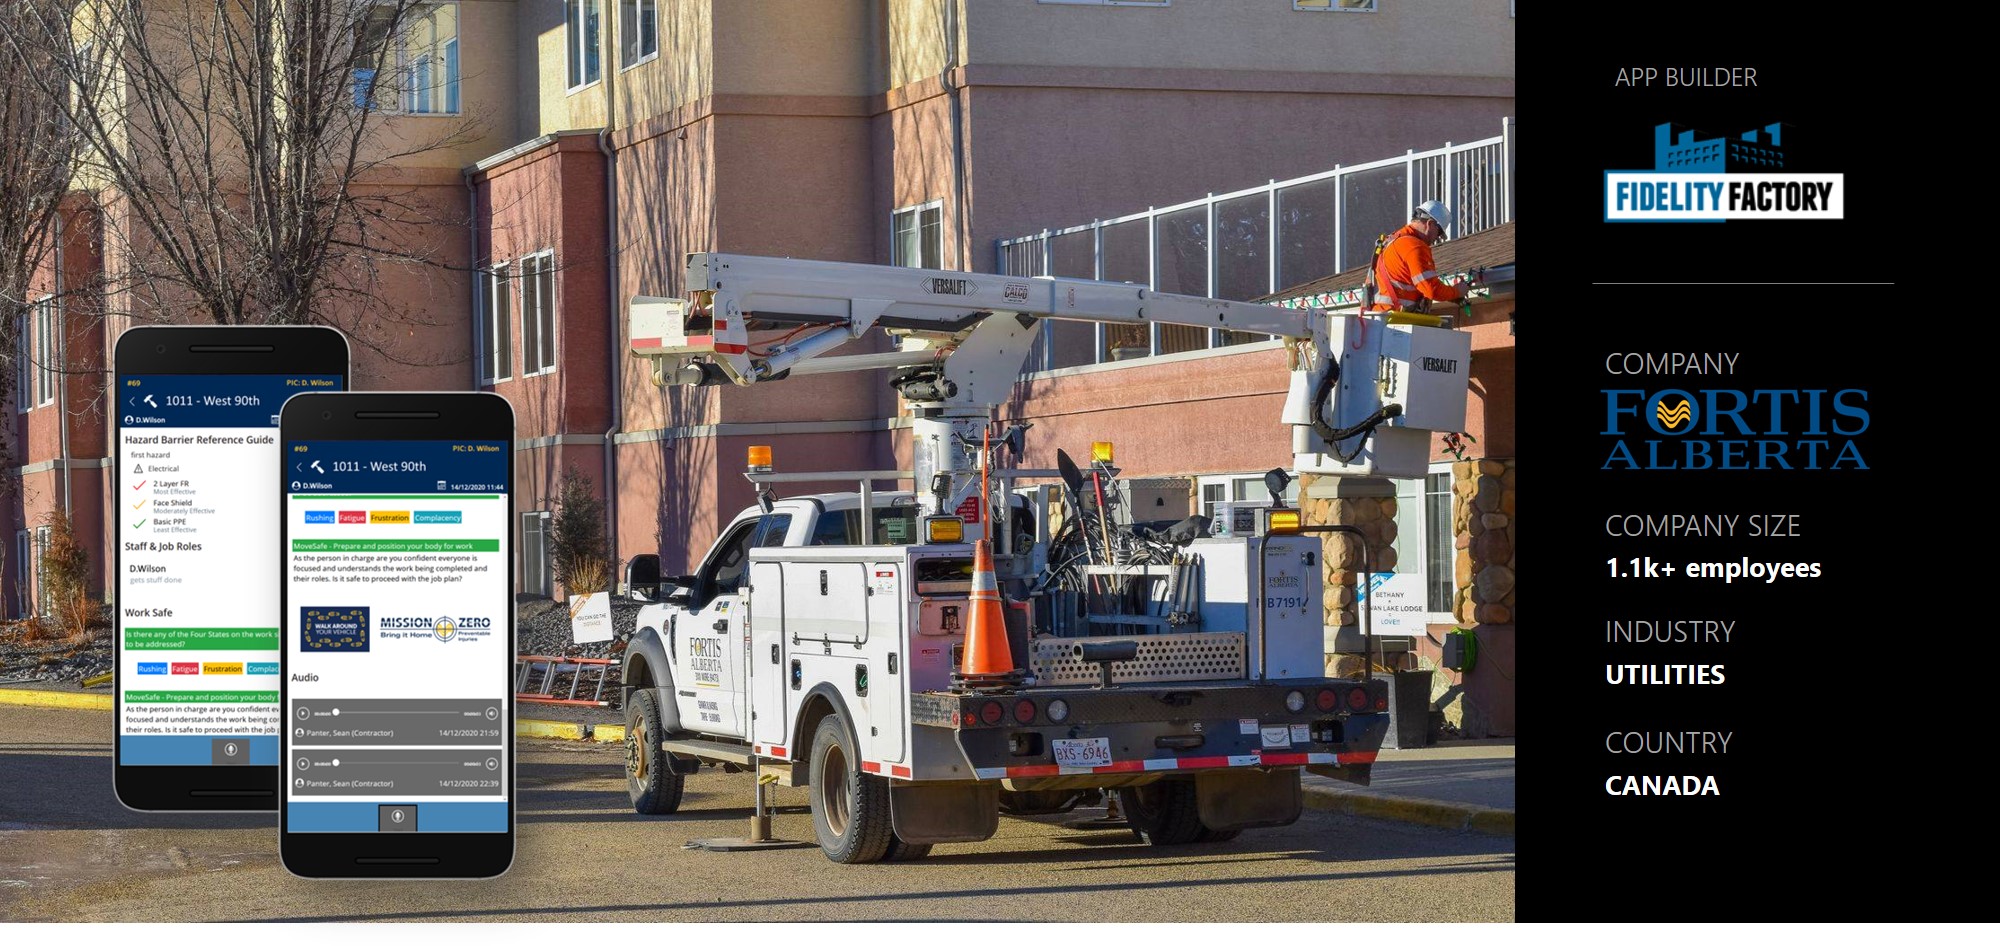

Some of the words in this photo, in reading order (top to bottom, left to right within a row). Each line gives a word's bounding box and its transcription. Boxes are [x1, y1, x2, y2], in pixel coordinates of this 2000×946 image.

[932, 278, 966, 296] VERSALIFT
[1423, 357, 1458, 374] VERSALIFT
[125, 435, 158, 444] Hazard
[161, 435, 194, 444] Barrier
[197, 435, 244, 444] Reference
[246, 435, 274, 444] Guide
[334, 461, 360, 472] 1011
[370, 462, 398, 472] West
[401, 461, 426, 471] 90th
[306, 515, 334, 523] Rushing
[339, 515, 365, 523] Fatigue
[415, 515, 461, 523] Complacency
[125, 542, 148, 551] Staff
[149, 542, 156, 551] &
[158, 542, 174, 552] Job
[176, 542, 202, 551] Roles
[333, 543, 360, 551] Prepare
[377, 543, 405, 551] position
[407, 543, 423, 551] your
[425, 543, 442, 551] body
[351, 555, 374, 563] charge
[130, 564, 166, 573] D.Wilson
[415, 565, 434, 573] being
[436, 565, 472, 573] completed
[430, 576, 442, 584] job
[125, 608, 150, 617] Work
[152, 608, 172, 617] Safe
[380, 618, 432, 628] MISSION
[458, 618, 490, 628] ZERO
[690, 638, 722, 658] FORTIS
[691, 658, 722, 672] ALBERTA
[291, 673, 319, 682] Audio
[351, 730, 394, 738] (Contractor)
[1056, 747, 1108, 760] BXS-6946
[333, 780, 350, 788] Sean
[352, 780, 393, 788] (Contractor)
[440, 780, 478, 788] 14/12/2020
